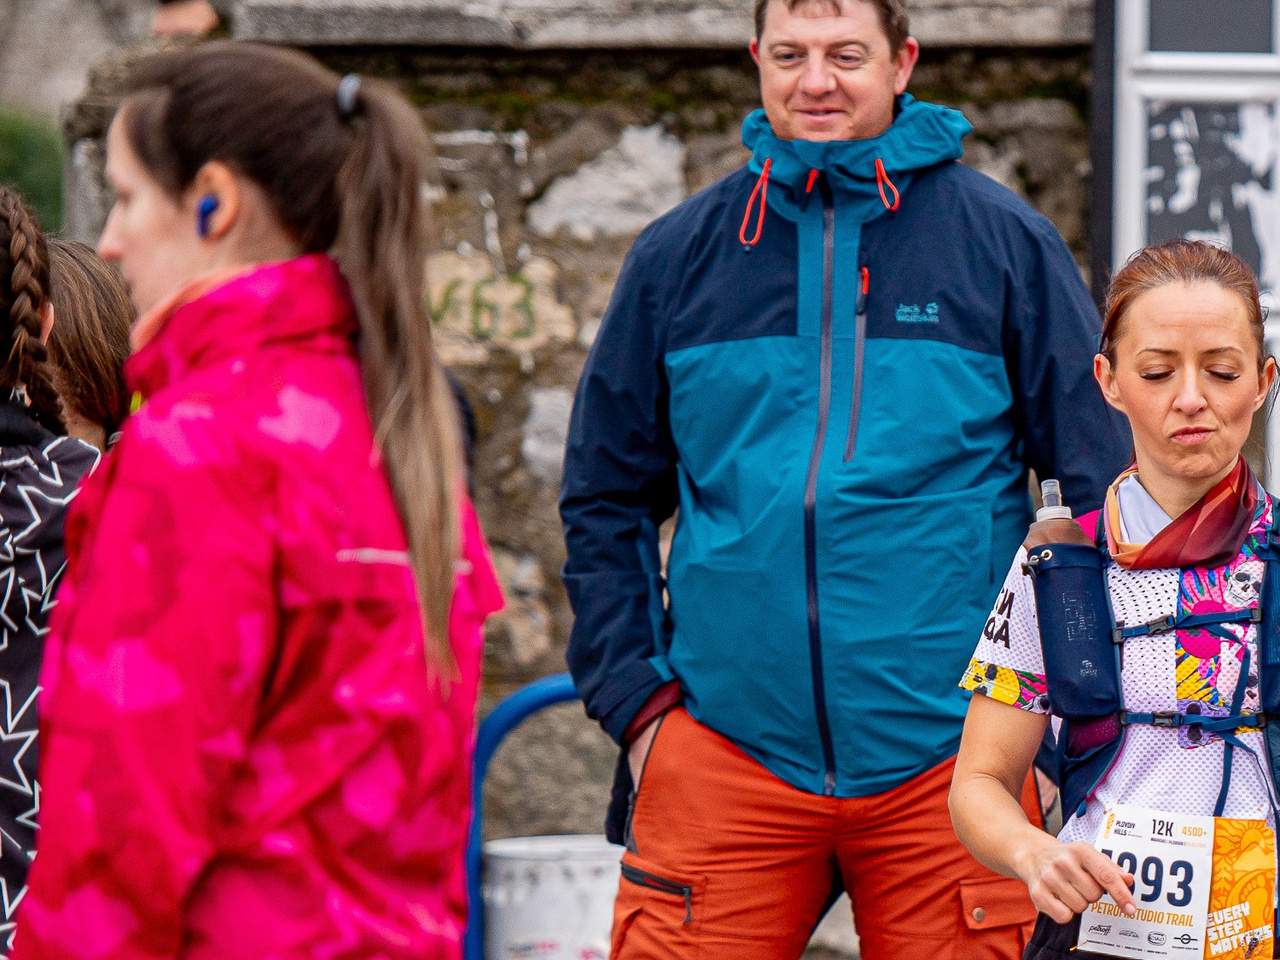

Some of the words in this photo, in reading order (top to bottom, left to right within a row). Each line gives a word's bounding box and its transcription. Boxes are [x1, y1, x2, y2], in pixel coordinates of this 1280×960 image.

[1152, 819, 1174, 837] 12K
[1166, 913, 1194, 928] TRAIL
[1206, 919, 1244, 941] STEP
[1209, 924, 1274, 956] MATTERS
